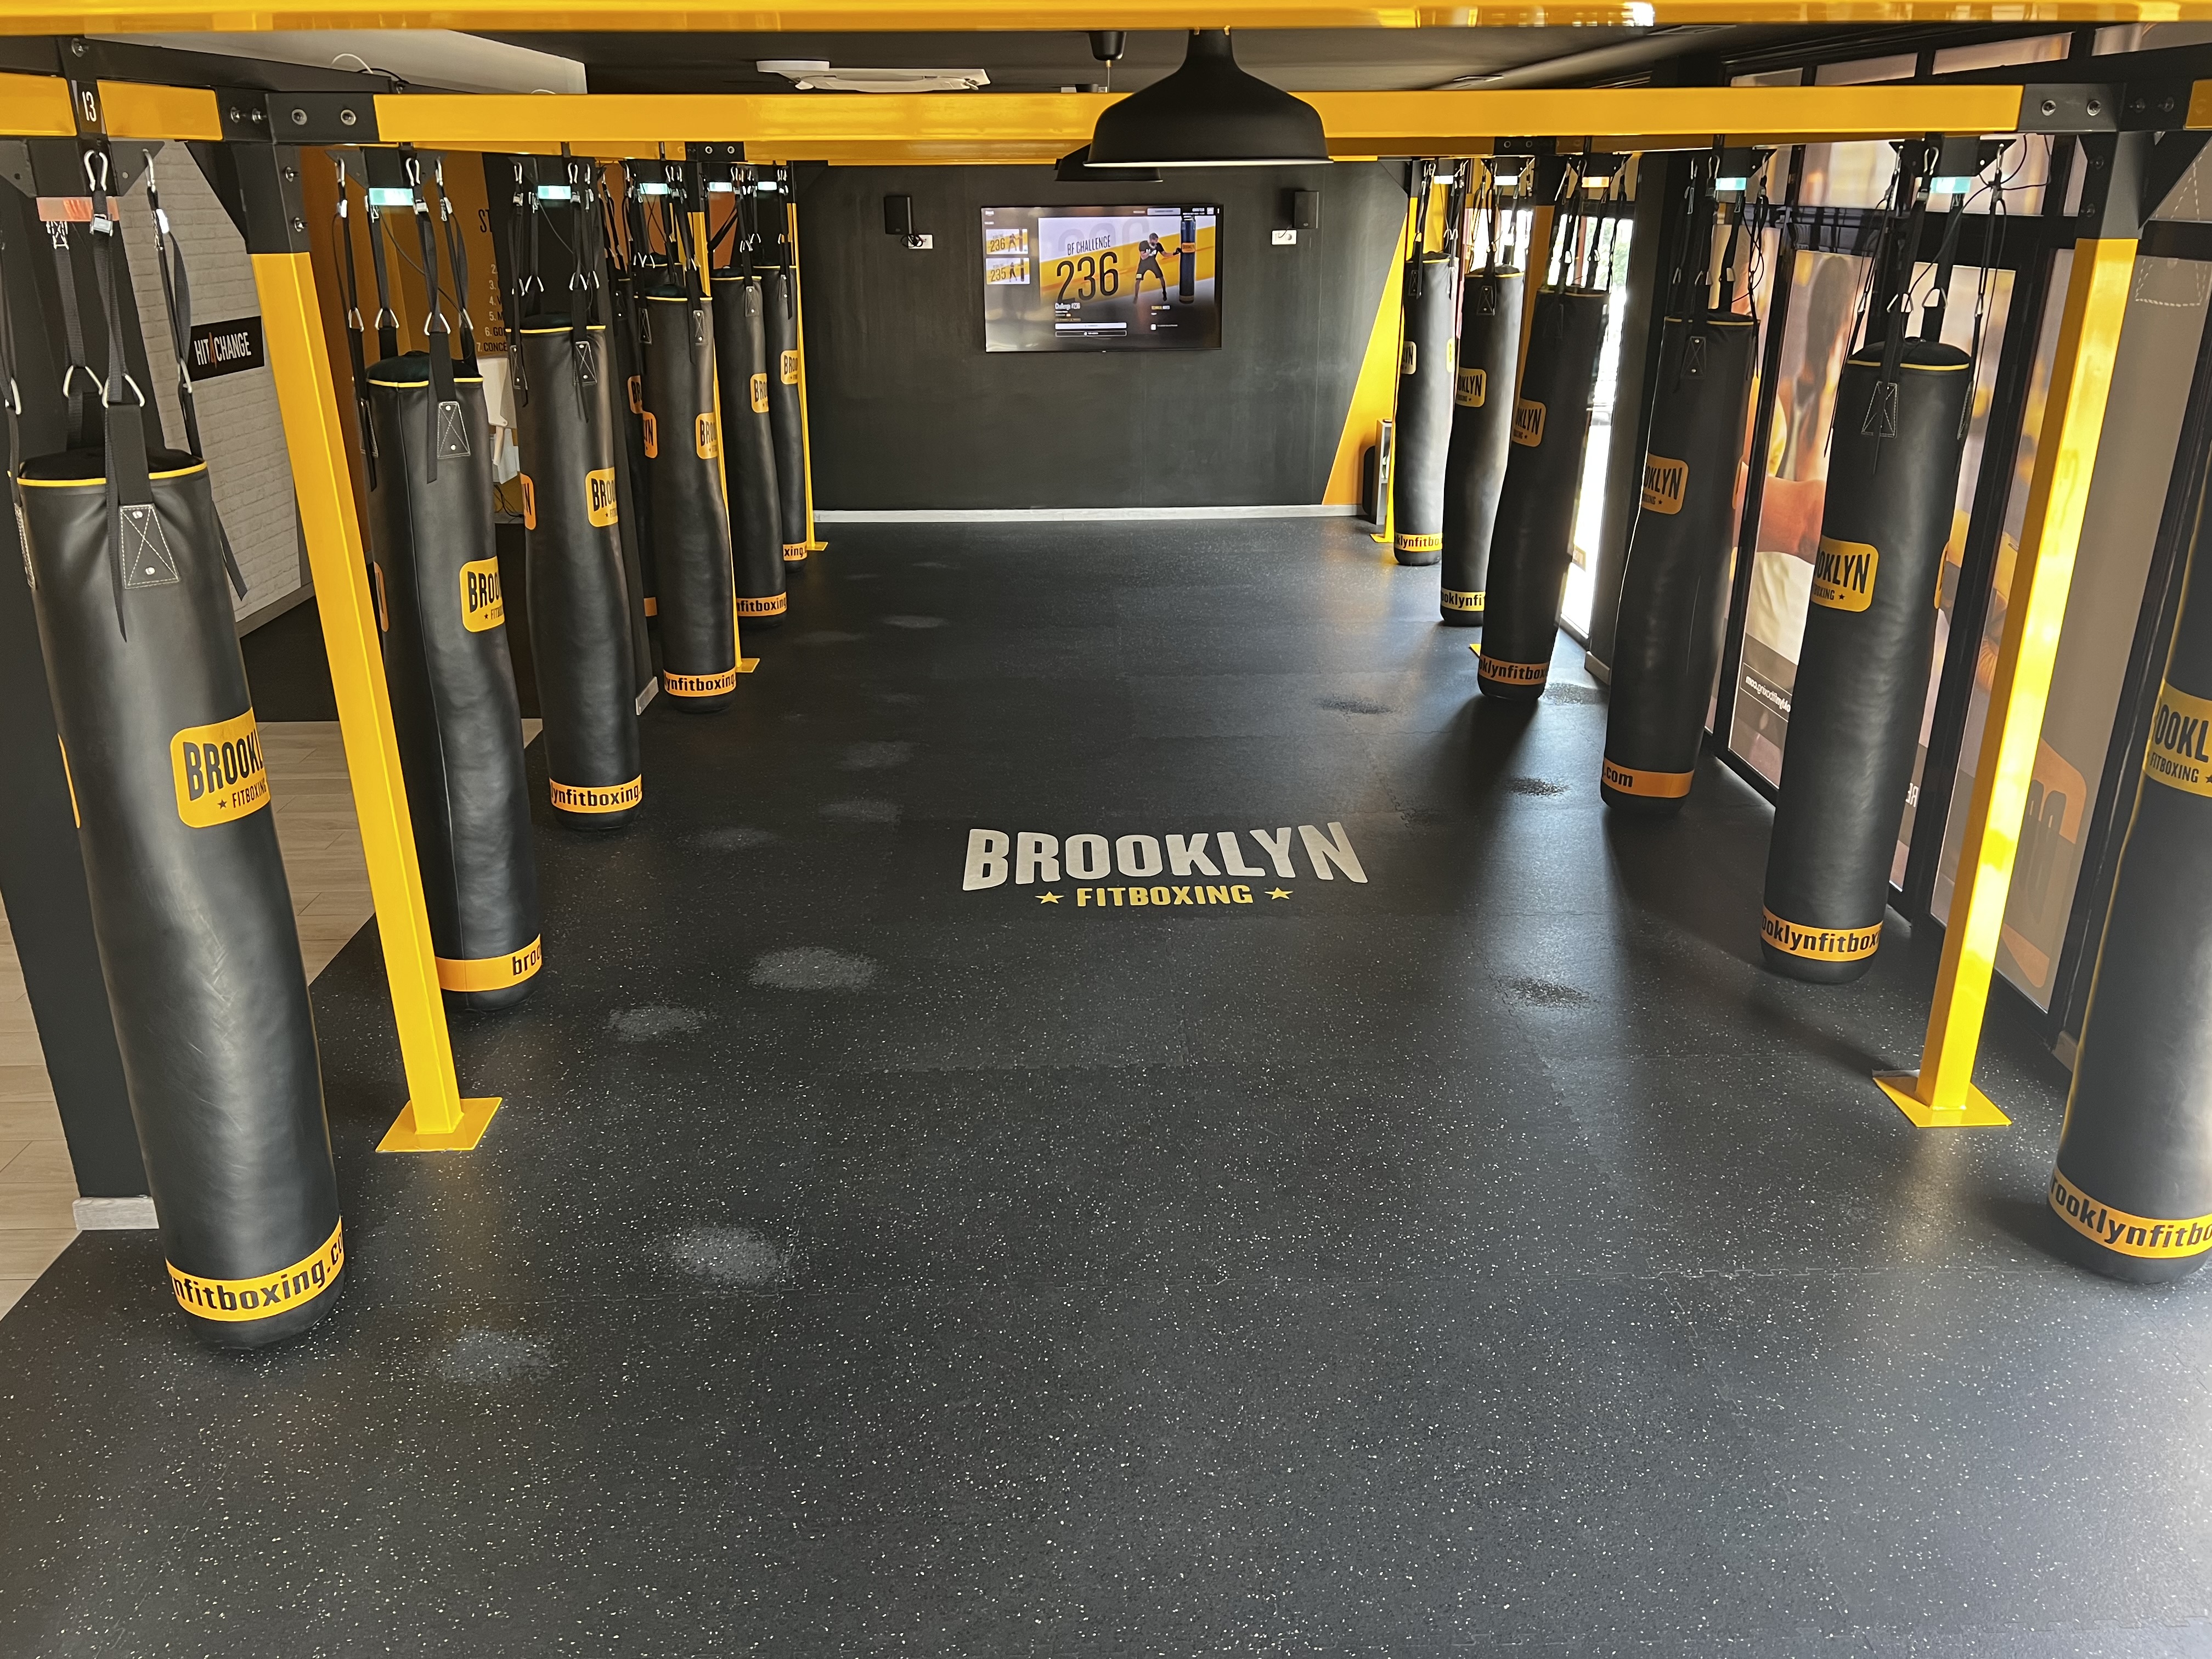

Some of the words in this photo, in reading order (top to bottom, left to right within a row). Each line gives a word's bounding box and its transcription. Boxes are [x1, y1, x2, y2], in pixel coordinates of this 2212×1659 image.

[82, 91, 97, 122] 13
[990, 238, 1006, 252] 236
[1067, 242, 1074, 256] BF
[1076, 235, 1111, 254] CHALLENGE
[991, 267, 1007, 282] 235
[1057, 251, 1119, 304] 236
[489, 311, 496, 321] 5.
[484, 326, 492, 336] 6.
[476, 342, 483, 352] 7.
[962, 821, 1369, 891] BROOKLYN
[1076, 885, 1254, 907] FITBOXING
